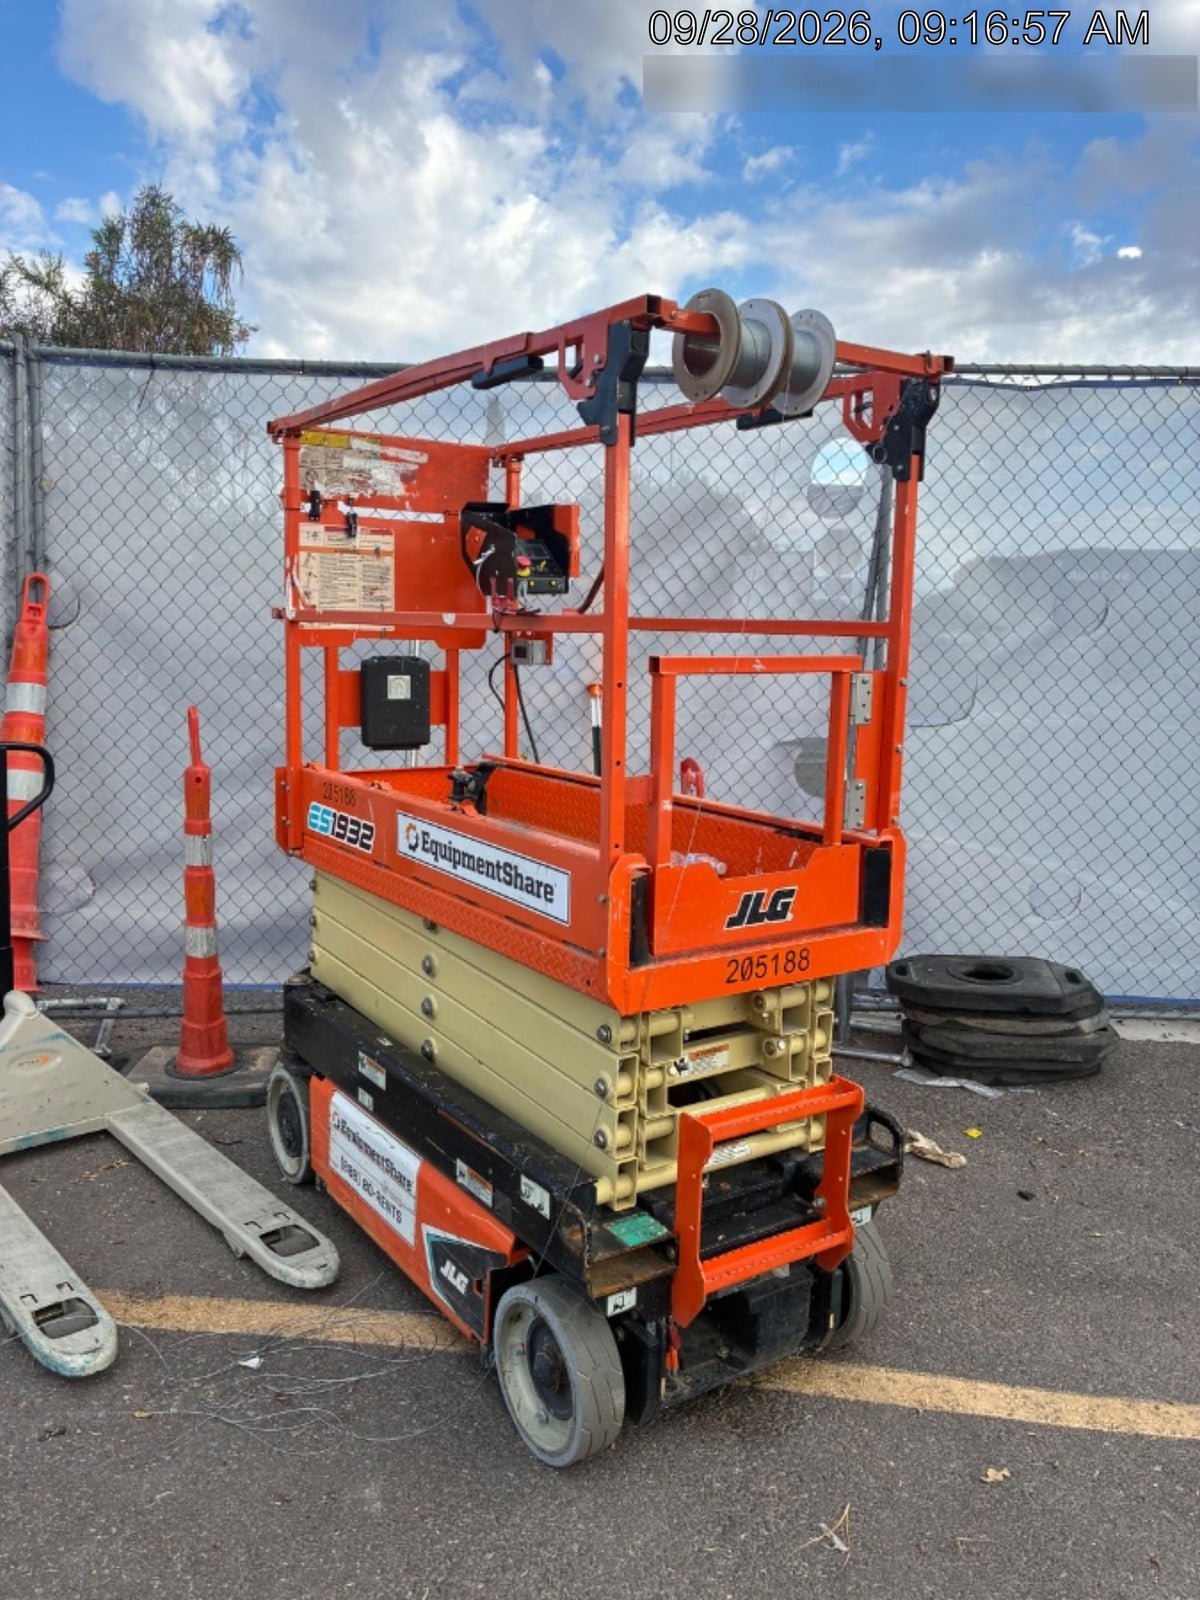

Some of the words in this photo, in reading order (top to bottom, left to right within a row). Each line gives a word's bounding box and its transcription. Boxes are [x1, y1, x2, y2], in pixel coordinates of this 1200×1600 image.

[308, 802, 375, 852] ES1932
[420, 829, 555, 904] EquipmentShare
[724, 887, 798, 929] JLG
[725, 947, 810, 984] 205188
[440, 1259, 469, 1295] JLG
